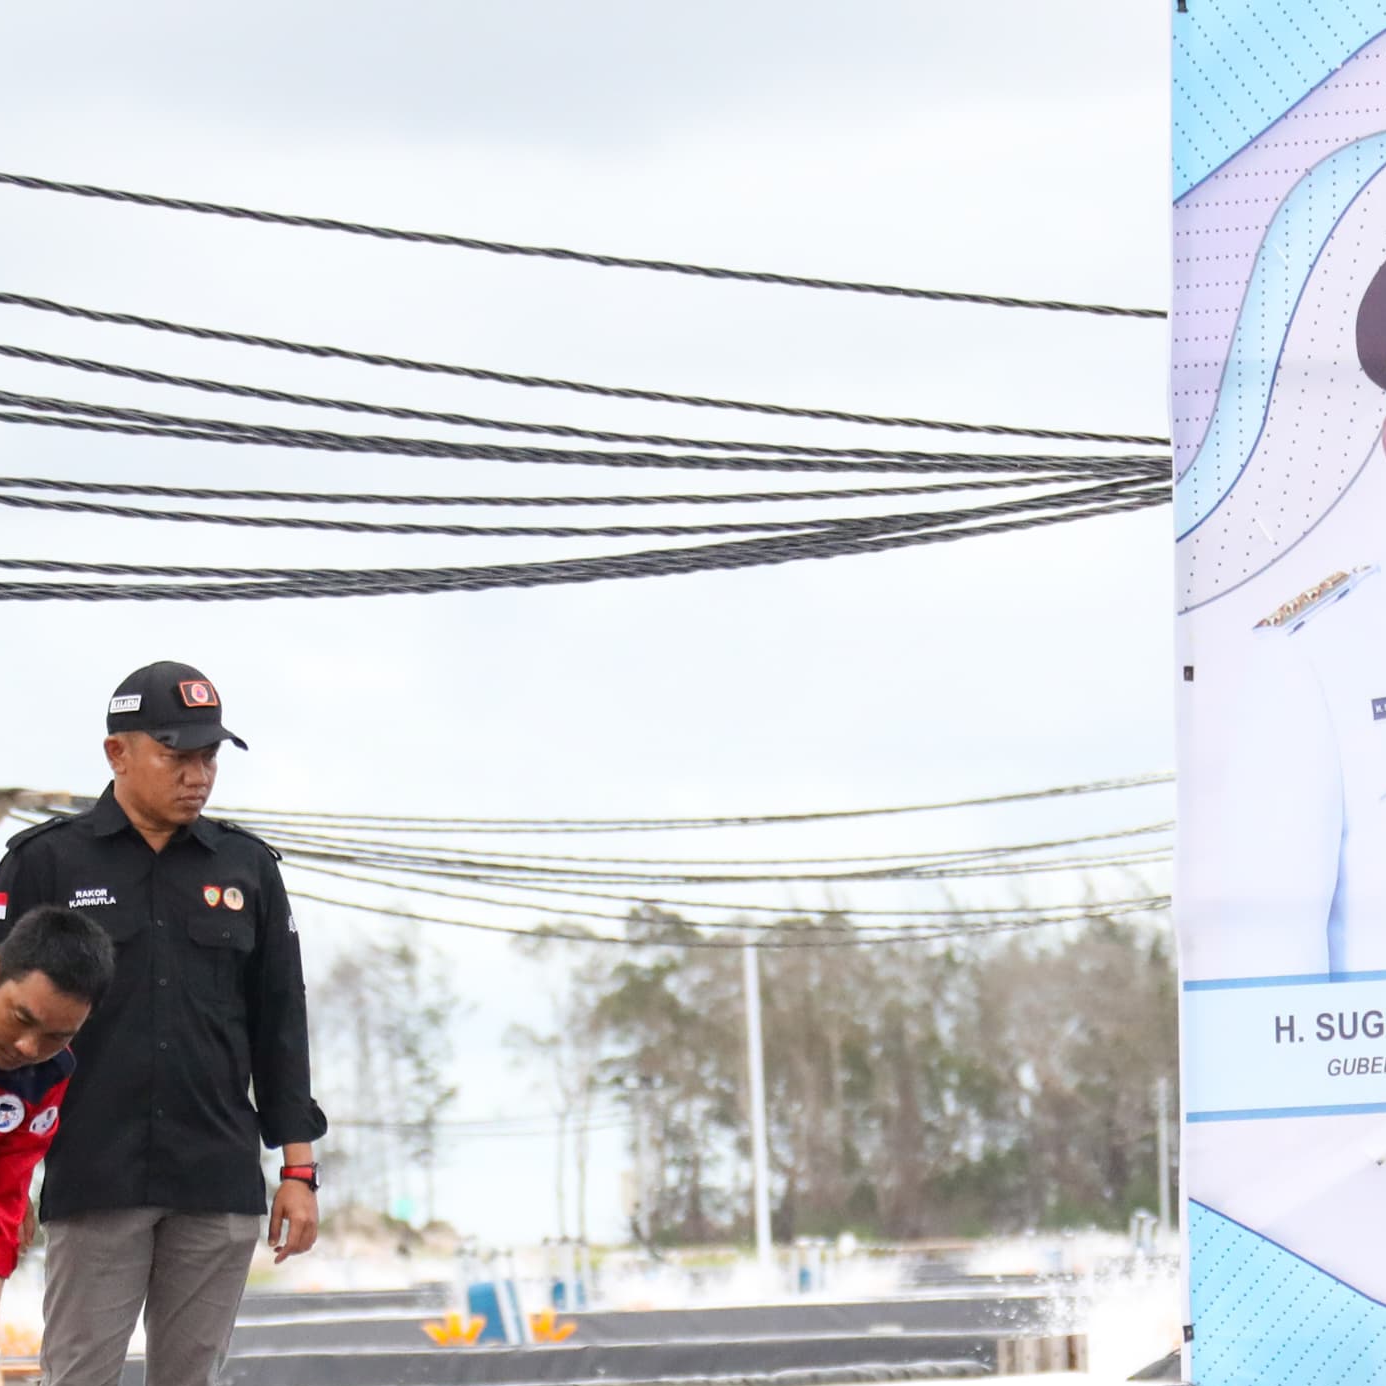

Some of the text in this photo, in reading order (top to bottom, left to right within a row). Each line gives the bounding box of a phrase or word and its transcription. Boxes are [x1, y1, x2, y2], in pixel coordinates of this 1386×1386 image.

[75, 888, 108, 899] RAKOR
[68, 896, 117, 909] KARHUTLA
[1276, 1015, 1303, 1043] H.
